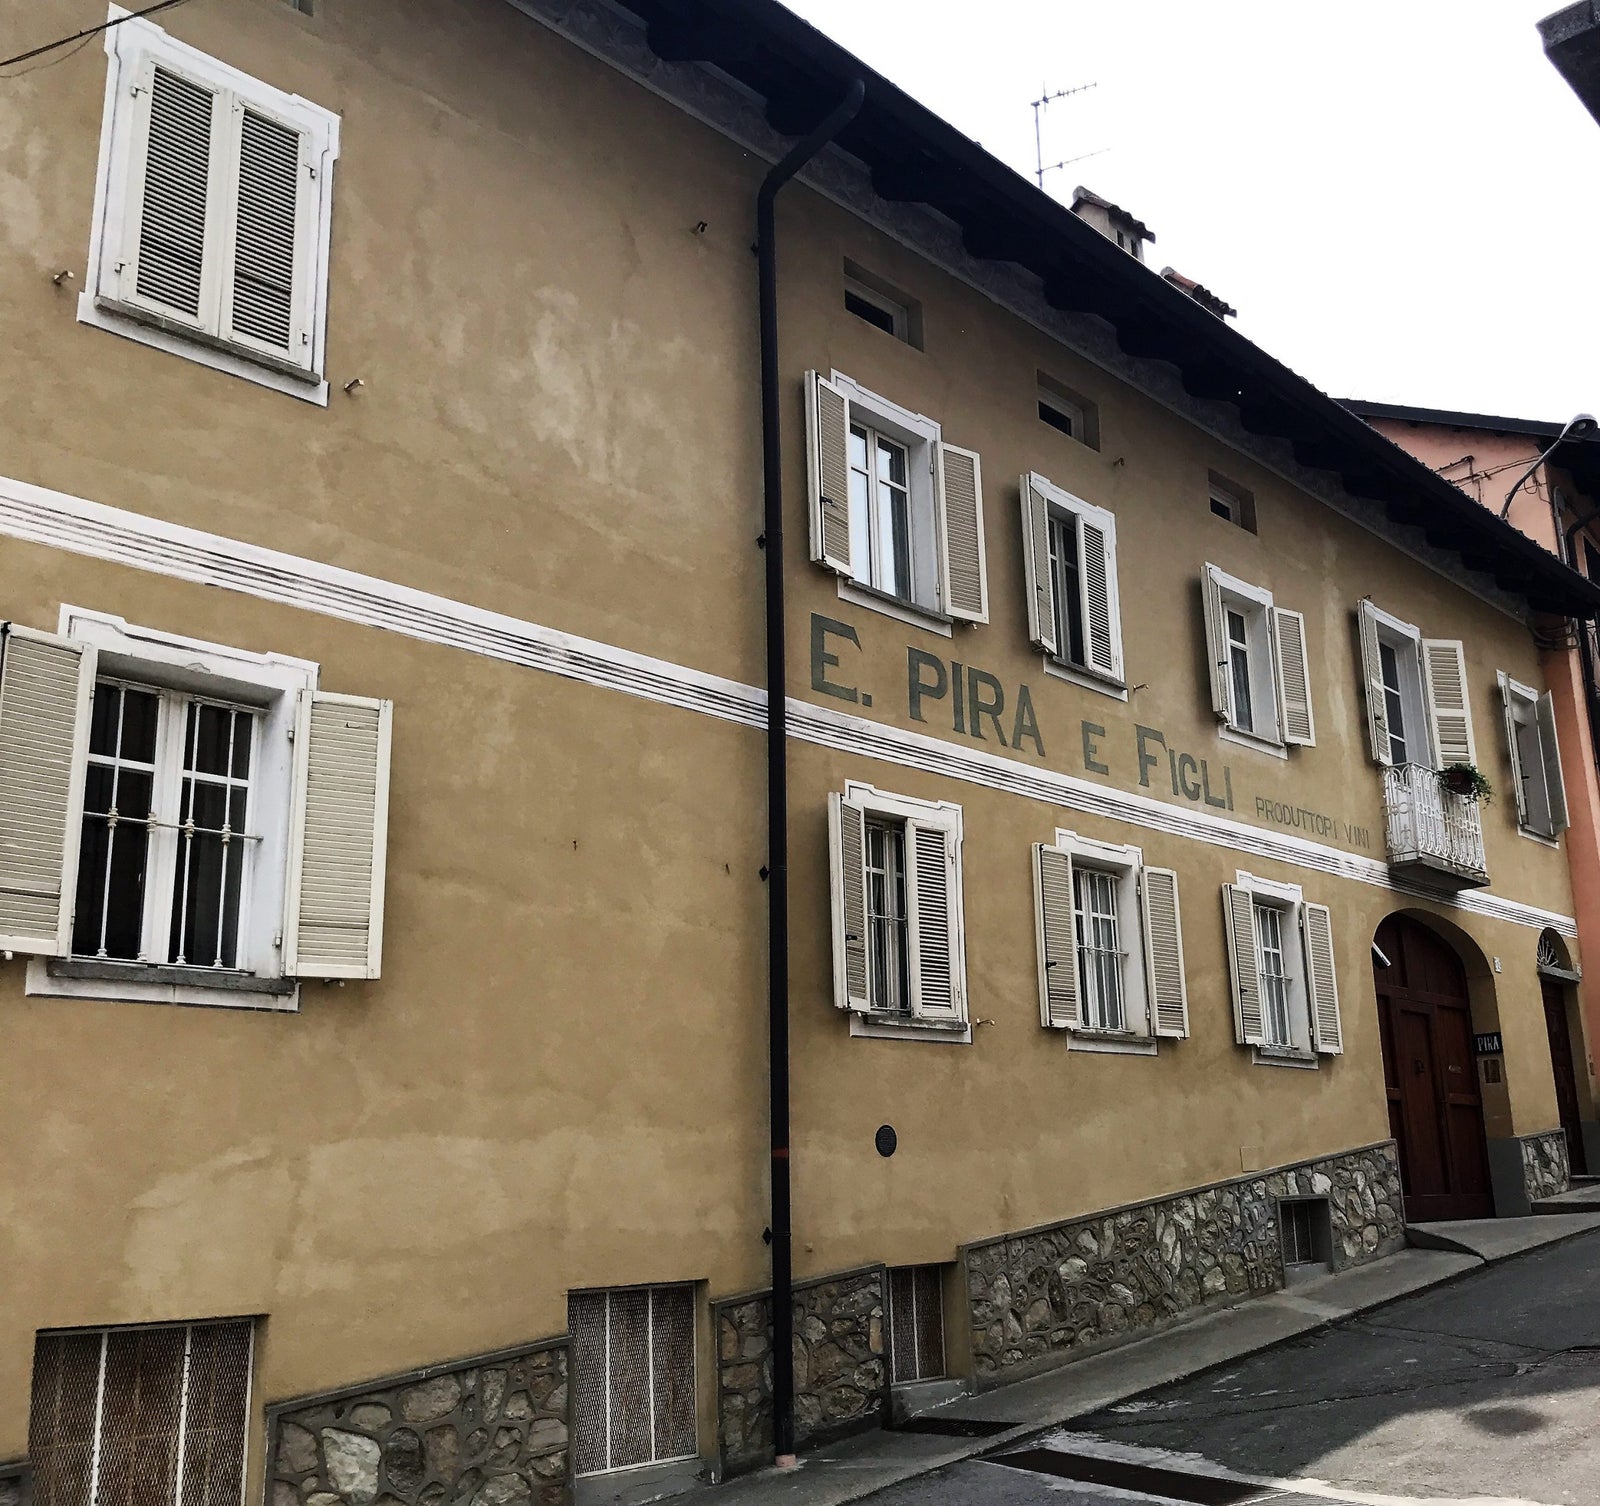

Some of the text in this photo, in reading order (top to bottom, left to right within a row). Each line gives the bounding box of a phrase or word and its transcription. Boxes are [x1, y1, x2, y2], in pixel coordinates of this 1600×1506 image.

[810, 612, 1234, 811] E. PIRA E FIGLI
[1344, 823, 1370, 849] VINI
[1478, 1036, 1499, 1051] PIRA
